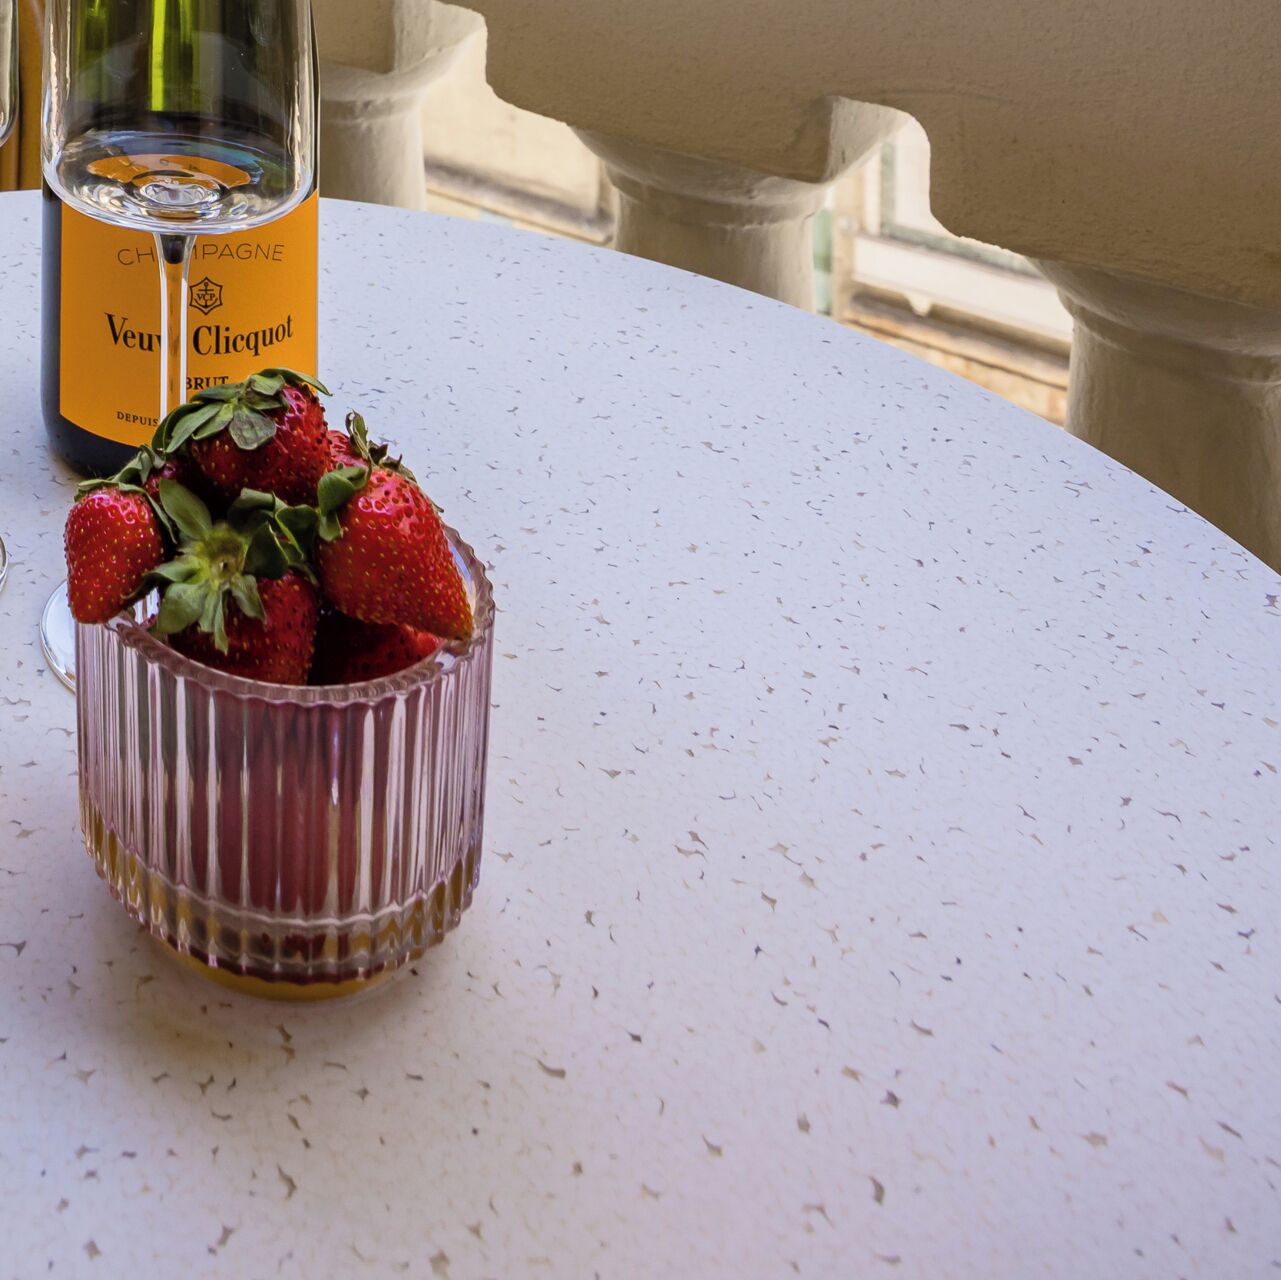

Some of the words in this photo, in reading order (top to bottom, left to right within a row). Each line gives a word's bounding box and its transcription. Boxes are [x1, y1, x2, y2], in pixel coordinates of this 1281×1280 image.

[117, 243, 285, 266] CHPAGNE
[103, 311, 162, 352] Veu
[192, 314, 294, 358] Clicquot
[186, 375, 228, 392] BRUT
[116, 410, 159, 428] DEPUIS
